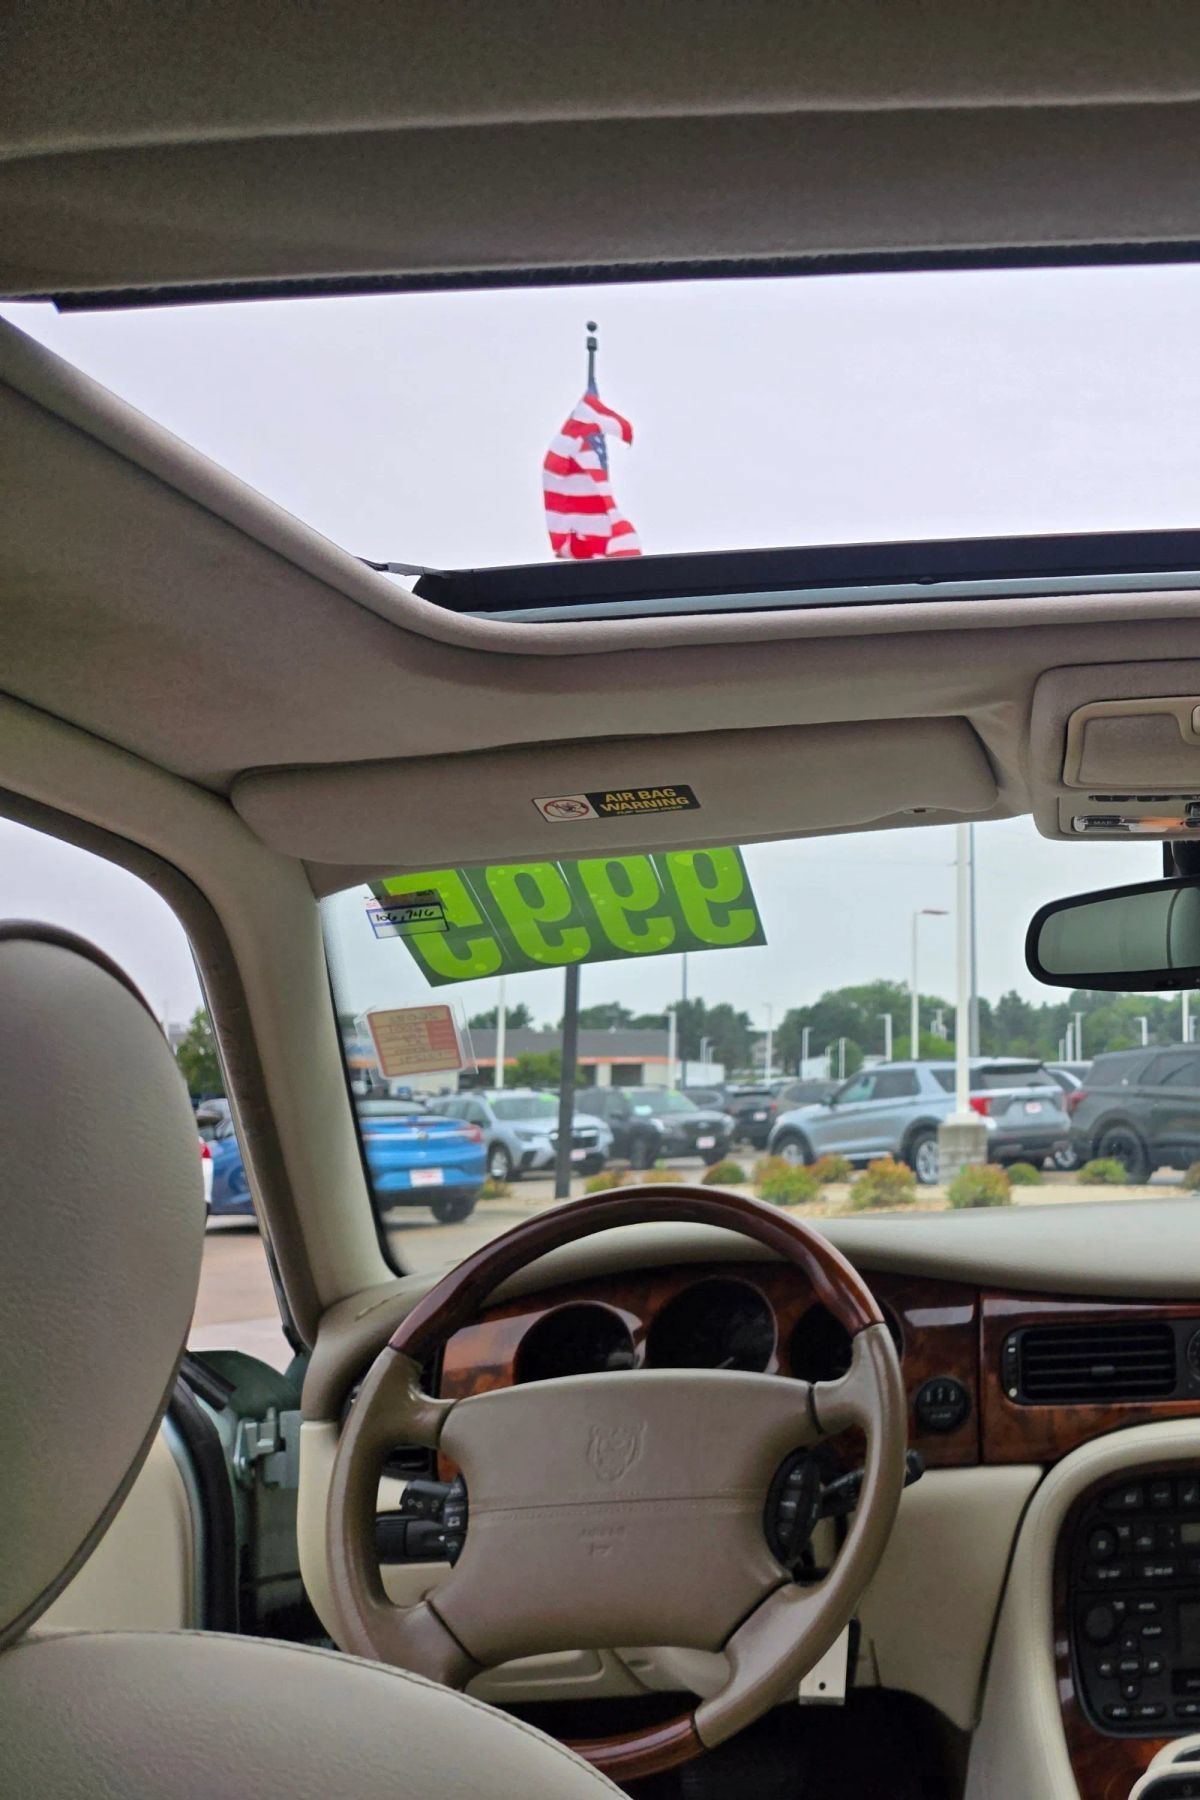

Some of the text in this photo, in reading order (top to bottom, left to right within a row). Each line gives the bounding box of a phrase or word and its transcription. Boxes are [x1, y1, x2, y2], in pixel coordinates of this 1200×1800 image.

[604, 787, 677, 803] AIR BAG
[600, 795, 690, 813] WARNING
